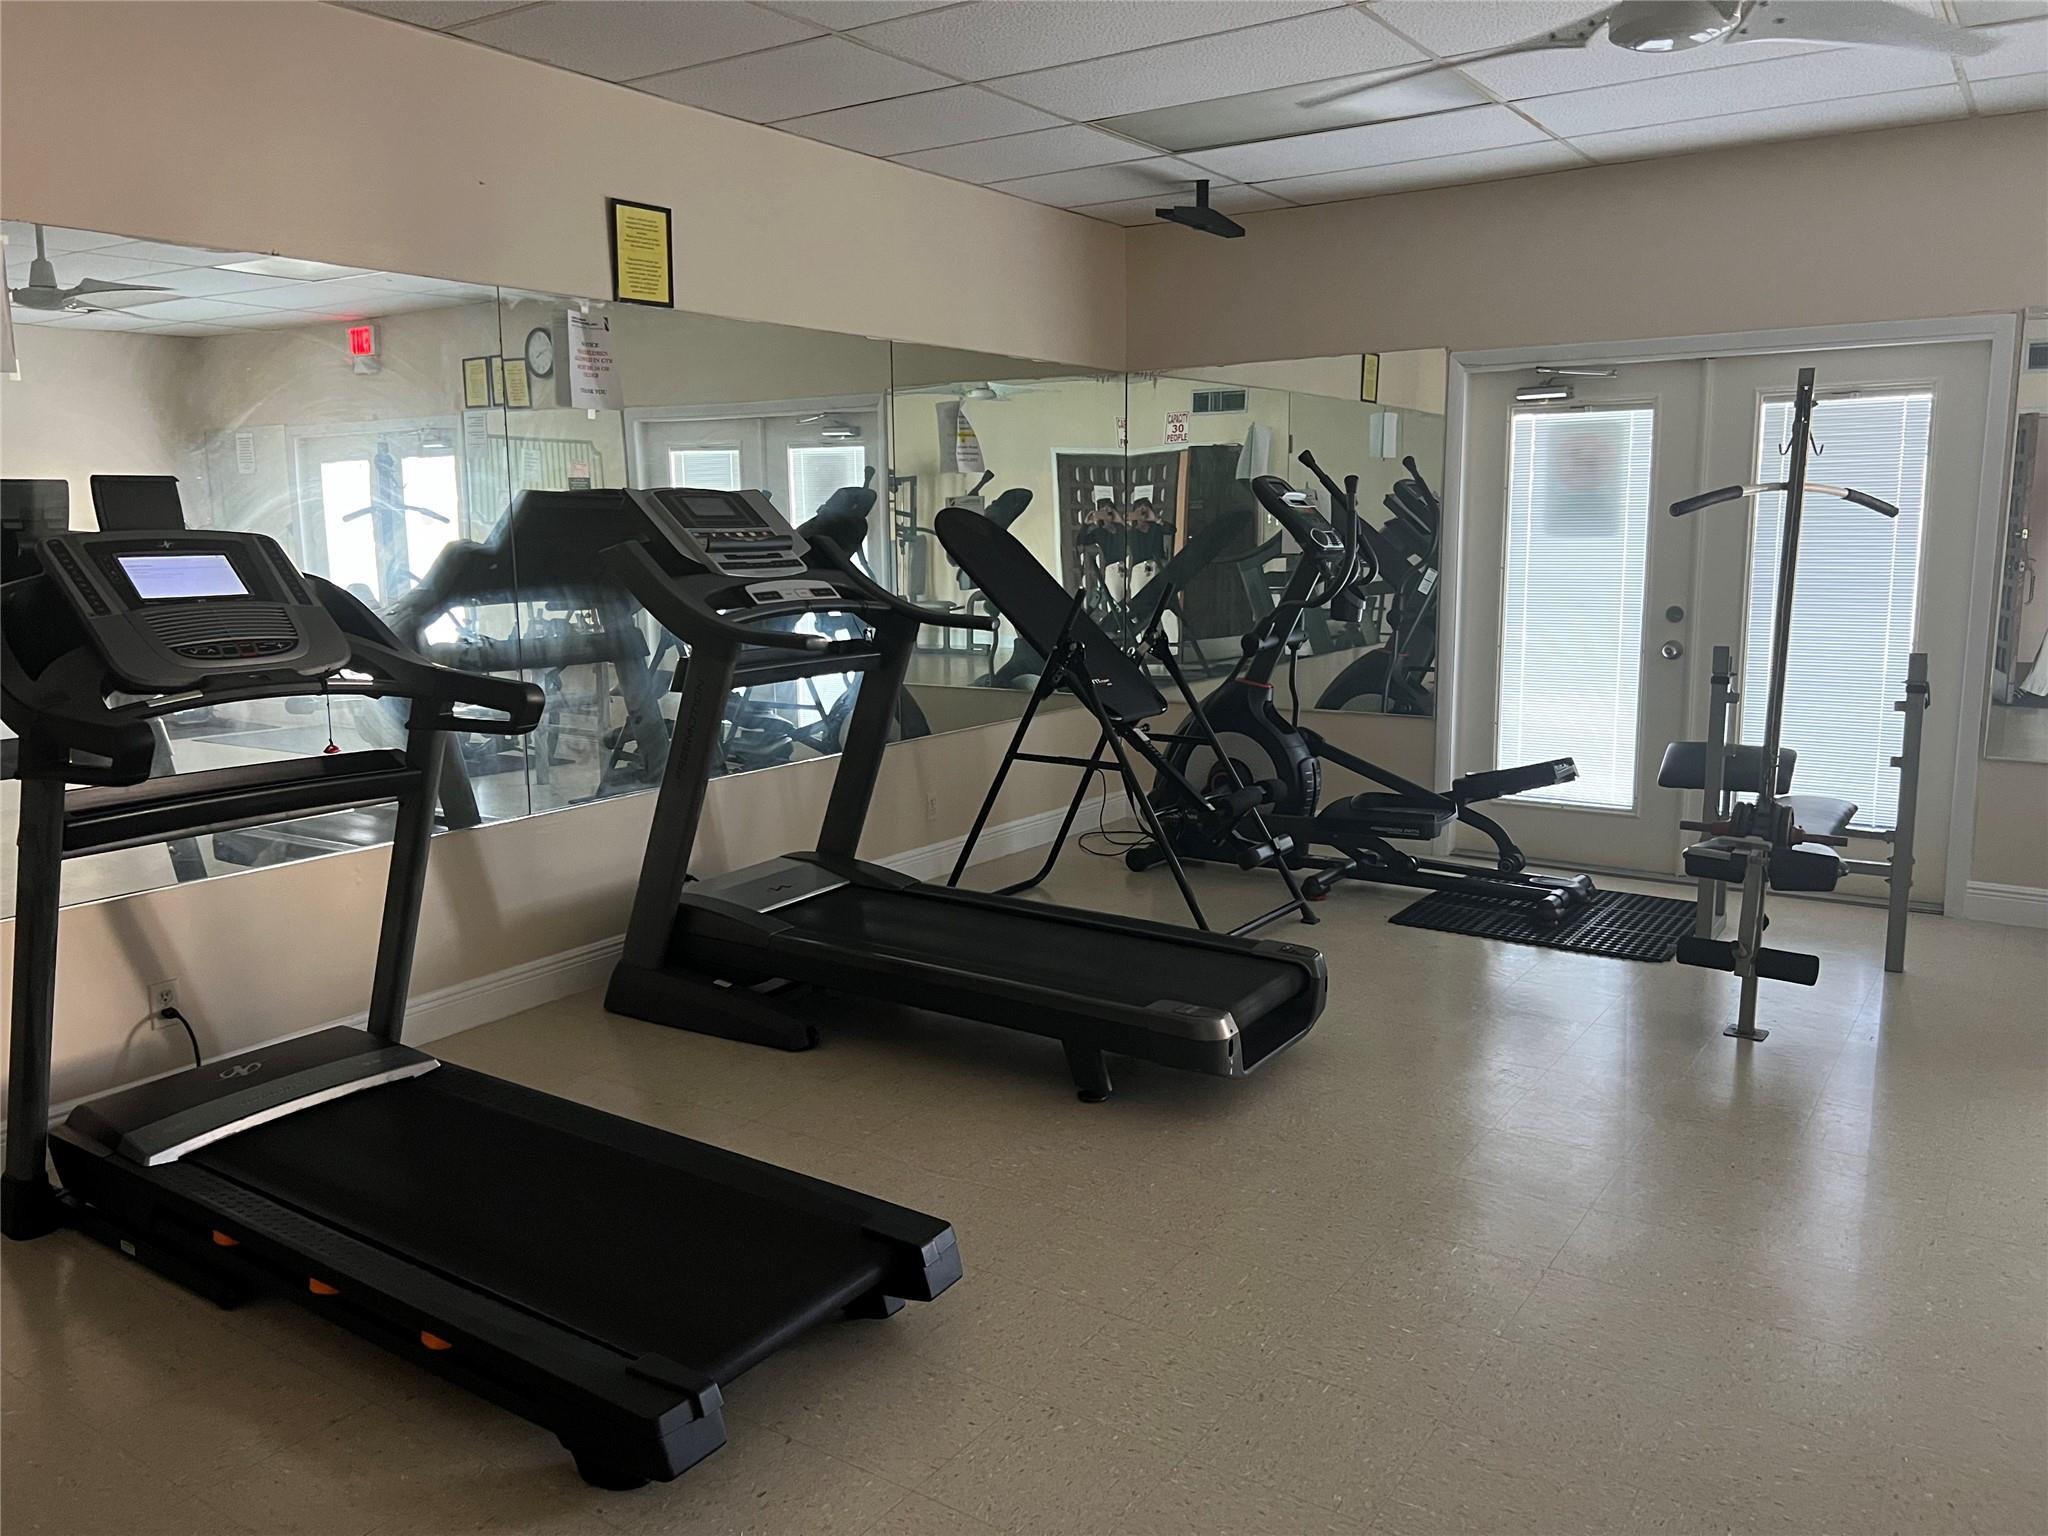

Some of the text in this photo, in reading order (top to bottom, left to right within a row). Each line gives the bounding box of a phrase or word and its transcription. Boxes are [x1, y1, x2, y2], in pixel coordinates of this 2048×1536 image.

[1168, 413, 1189, 424] CAPACITY
[1172, 424, 1184, 433] 30
[1167, 433, 1188, 442] PEOPLE
